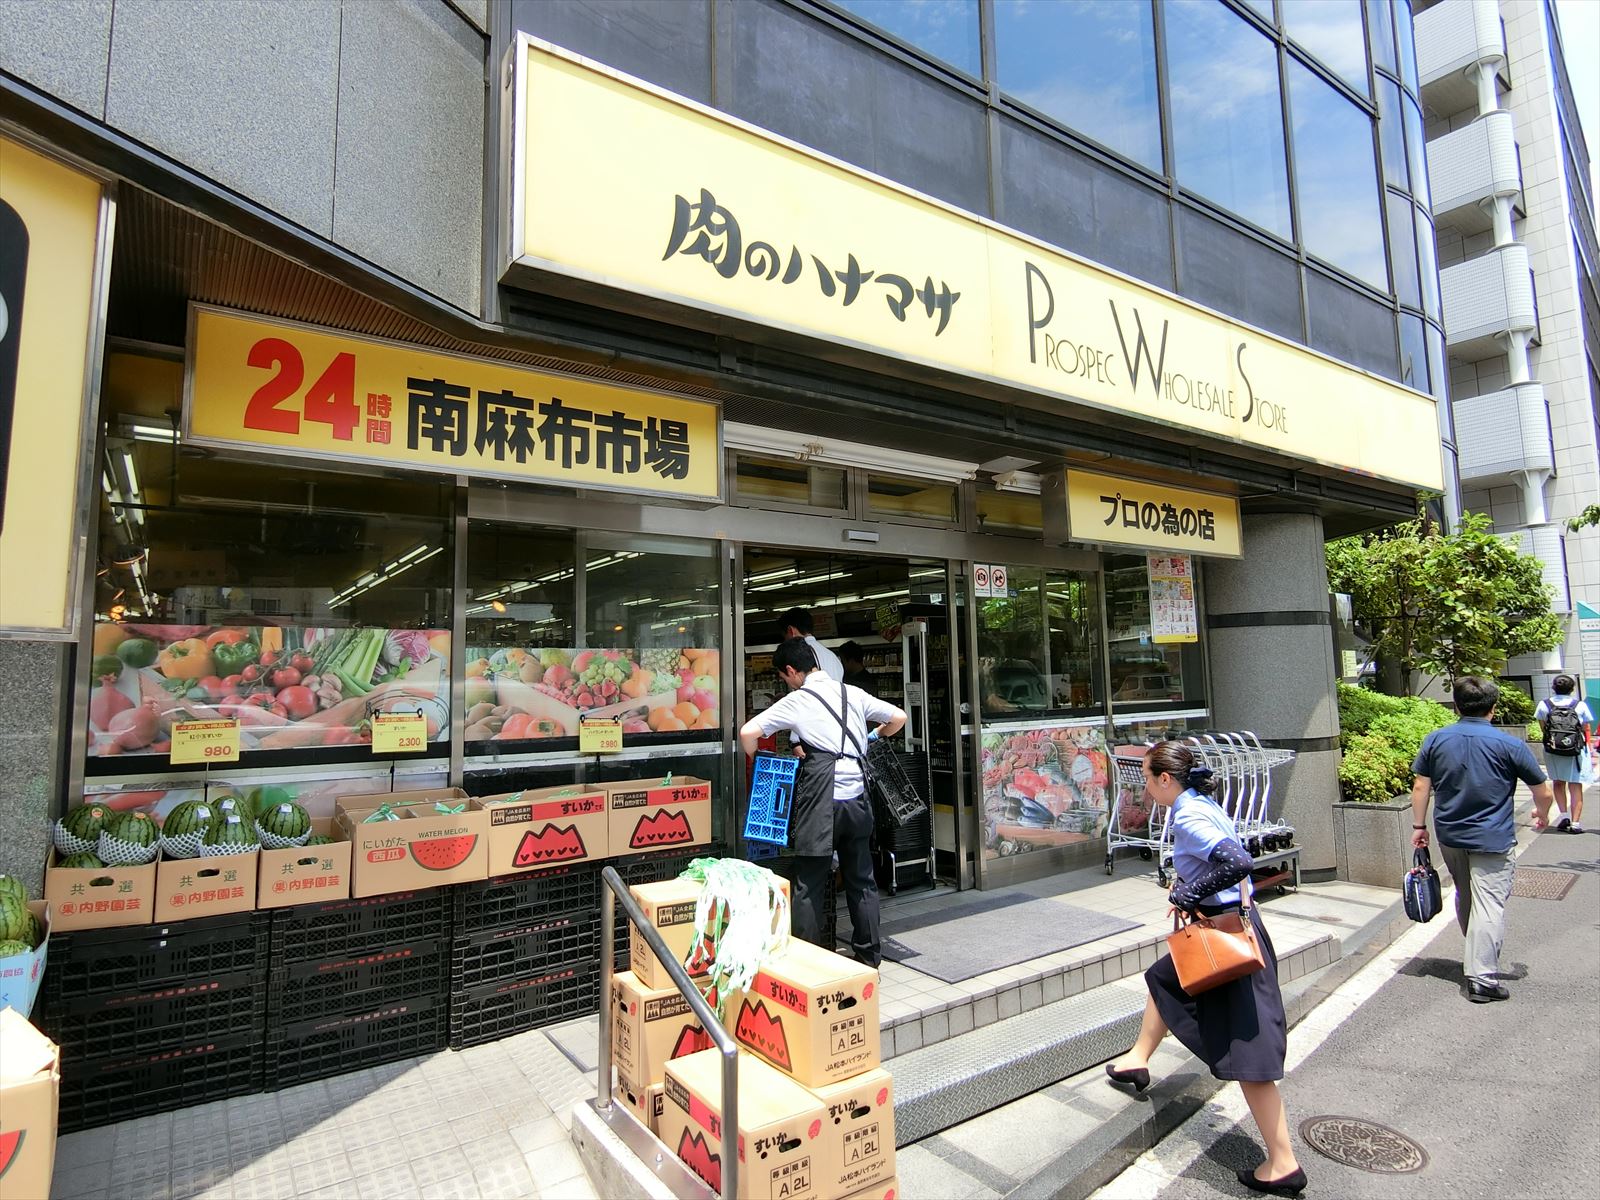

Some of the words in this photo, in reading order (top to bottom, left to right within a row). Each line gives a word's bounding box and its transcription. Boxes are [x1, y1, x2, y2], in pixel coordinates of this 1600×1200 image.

[662, 188, 961, 337] 肉のハナマサ
[243, 338, 360, 441] 24
[406, 377, 690, 480] 南麻布市場
[1099, 493, 1216, 541] プロの為の店
[204, 746, 232, 757] 980
[418, 830, 443, 839] WATER
[443, 827, 469, 836] MELON
[363, 837, 406, 850] にいがた
[372, 850, 401, 862] 西瓜
[816, 990, 845, 1008] すいか
[838, 1038, 846, 1050] A
[851, 1033, 863, 1046] 2L
[828, 1099, 858, 1118] すいか
[754, 1132, 788, 1153] すいか
[851, 1148, 860, 1161] A
[864, 1142, 878, 1155] 2L
[838, 1158, 886, 1184] JA松本ハイランド
[779, 1182, 790, 1198] A
[793, 1177, 809, 1191] 2L
